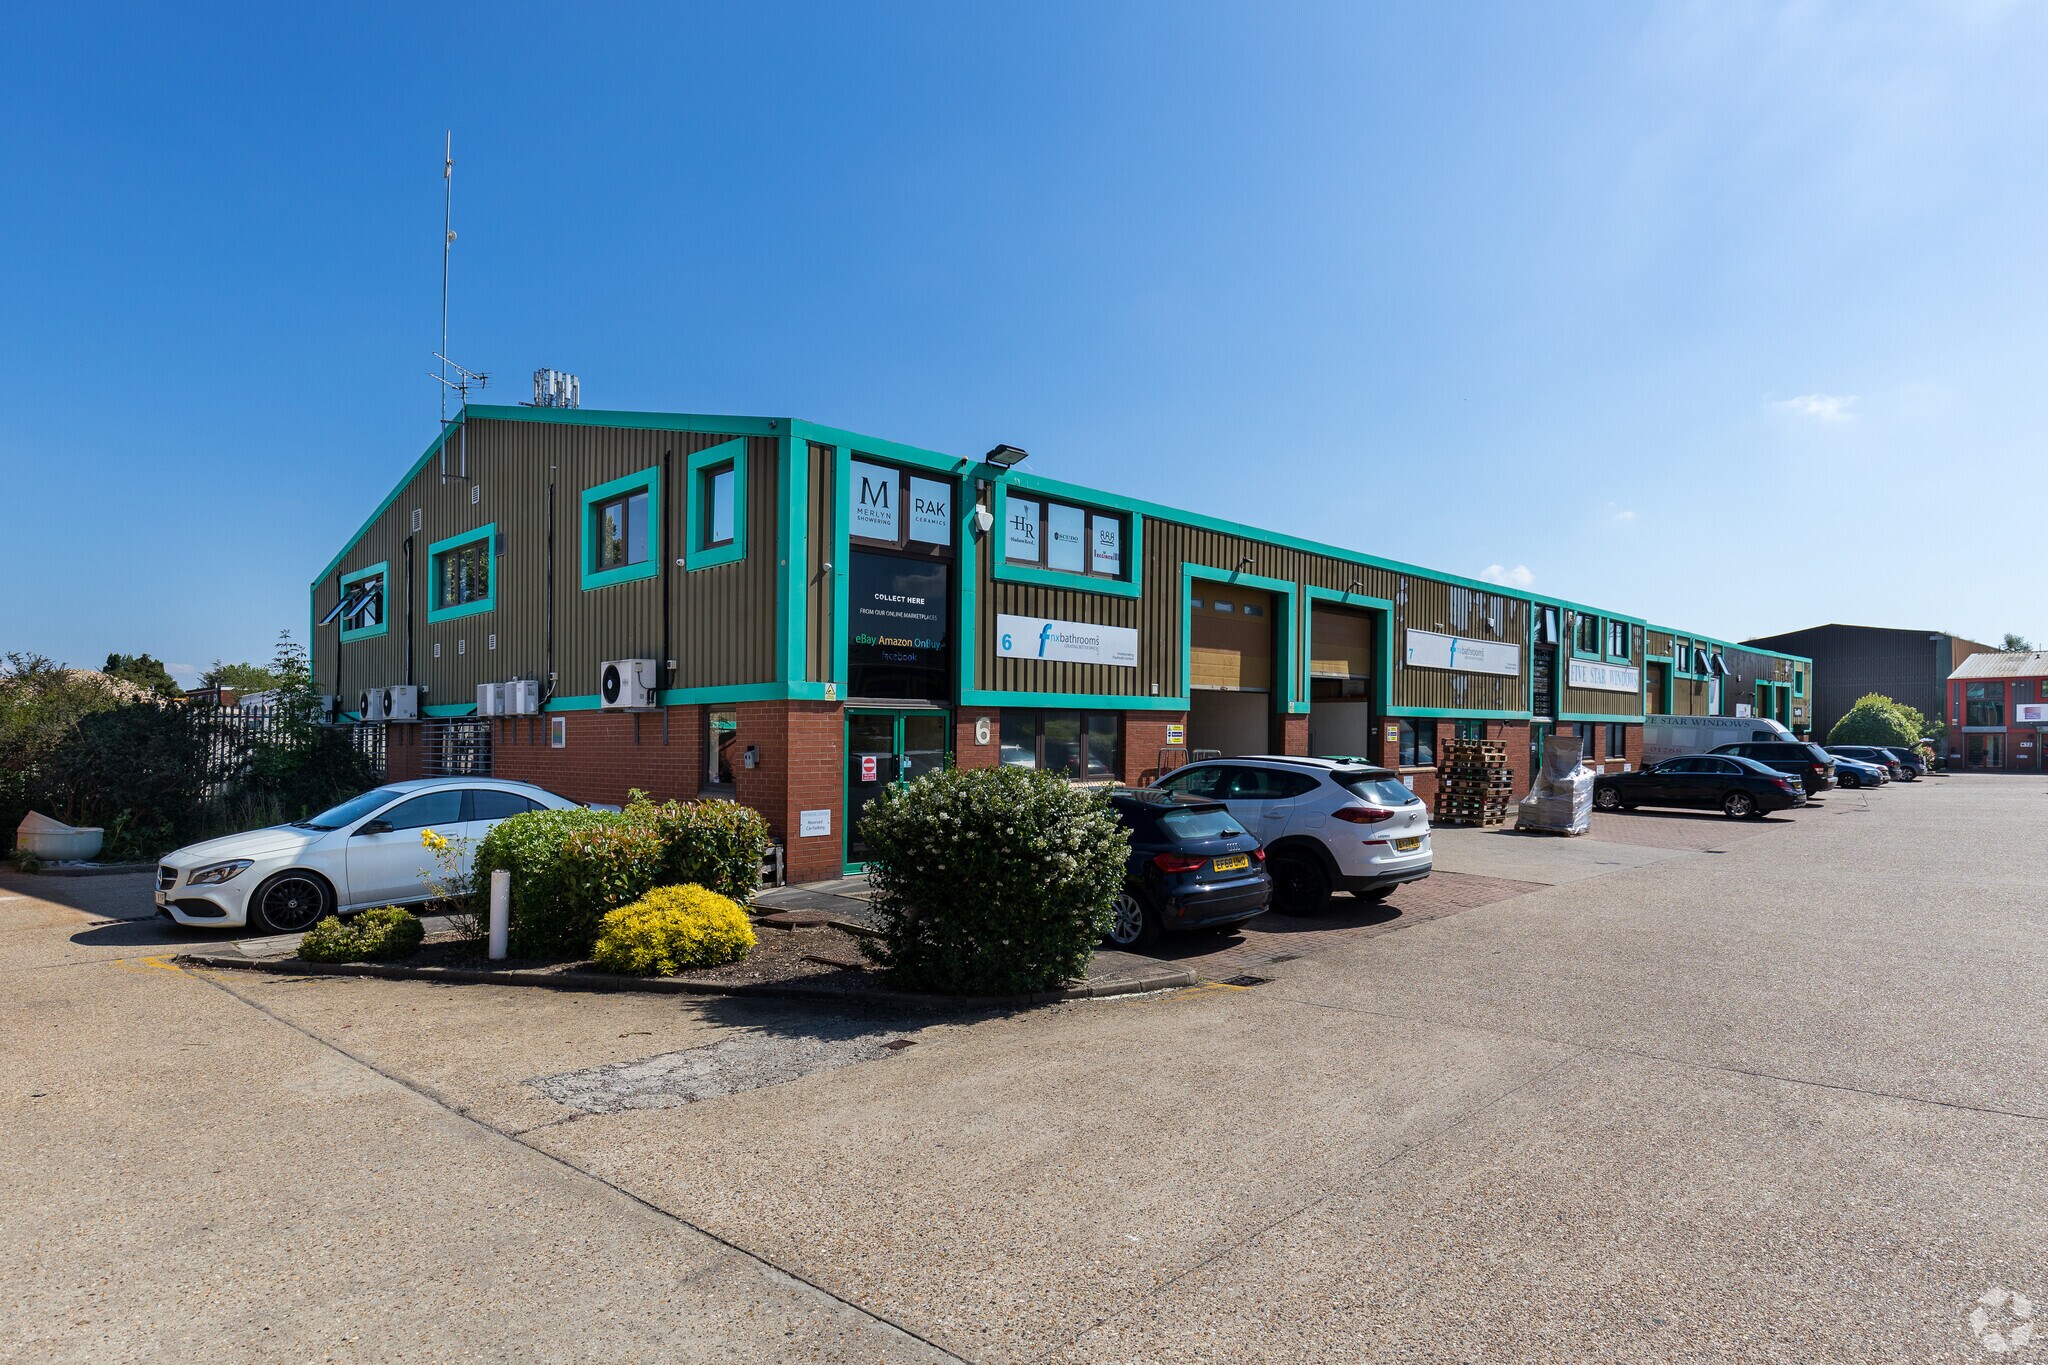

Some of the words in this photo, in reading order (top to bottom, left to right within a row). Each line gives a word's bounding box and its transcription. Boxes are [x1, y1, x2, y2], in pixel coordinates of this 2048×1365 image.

[860, 476, 889, 509] M
[857, 508, 892, 519] MERLYN
[915, 498, 946, 517] RAK
[857, 515, 891, 526] SHOWERING
[915, 516, 946, 526] CERAMICS
[874, 593, 906, 603] COLLECT
[906, 597, 925, 605] HERE
[860, 607, 874, 615] FROM
[886, 610, 903, 618] ONLINE
[903, 612, 938, 621] MARKETPLACES
[855, 633, 877, 647] eBay
[878, 635, 913, 647] Amazon
[914, 637, 941, 651] OnBuy
[1001, 633, 1013, 651] 6
[882, 650, 917, 661] facebook
[1408, 648, 1414, 659] 7
[1571, 664, 1587, 682] FIVE
[1590, 667, 1606, 685] STAR
[1609, 669, 1638, 688] WINDOWS
[1660, 717, 1687, 726] STAR
[1689, 718, 1751, 728] WINDOWS
[976, 716, 990, 744] 6
